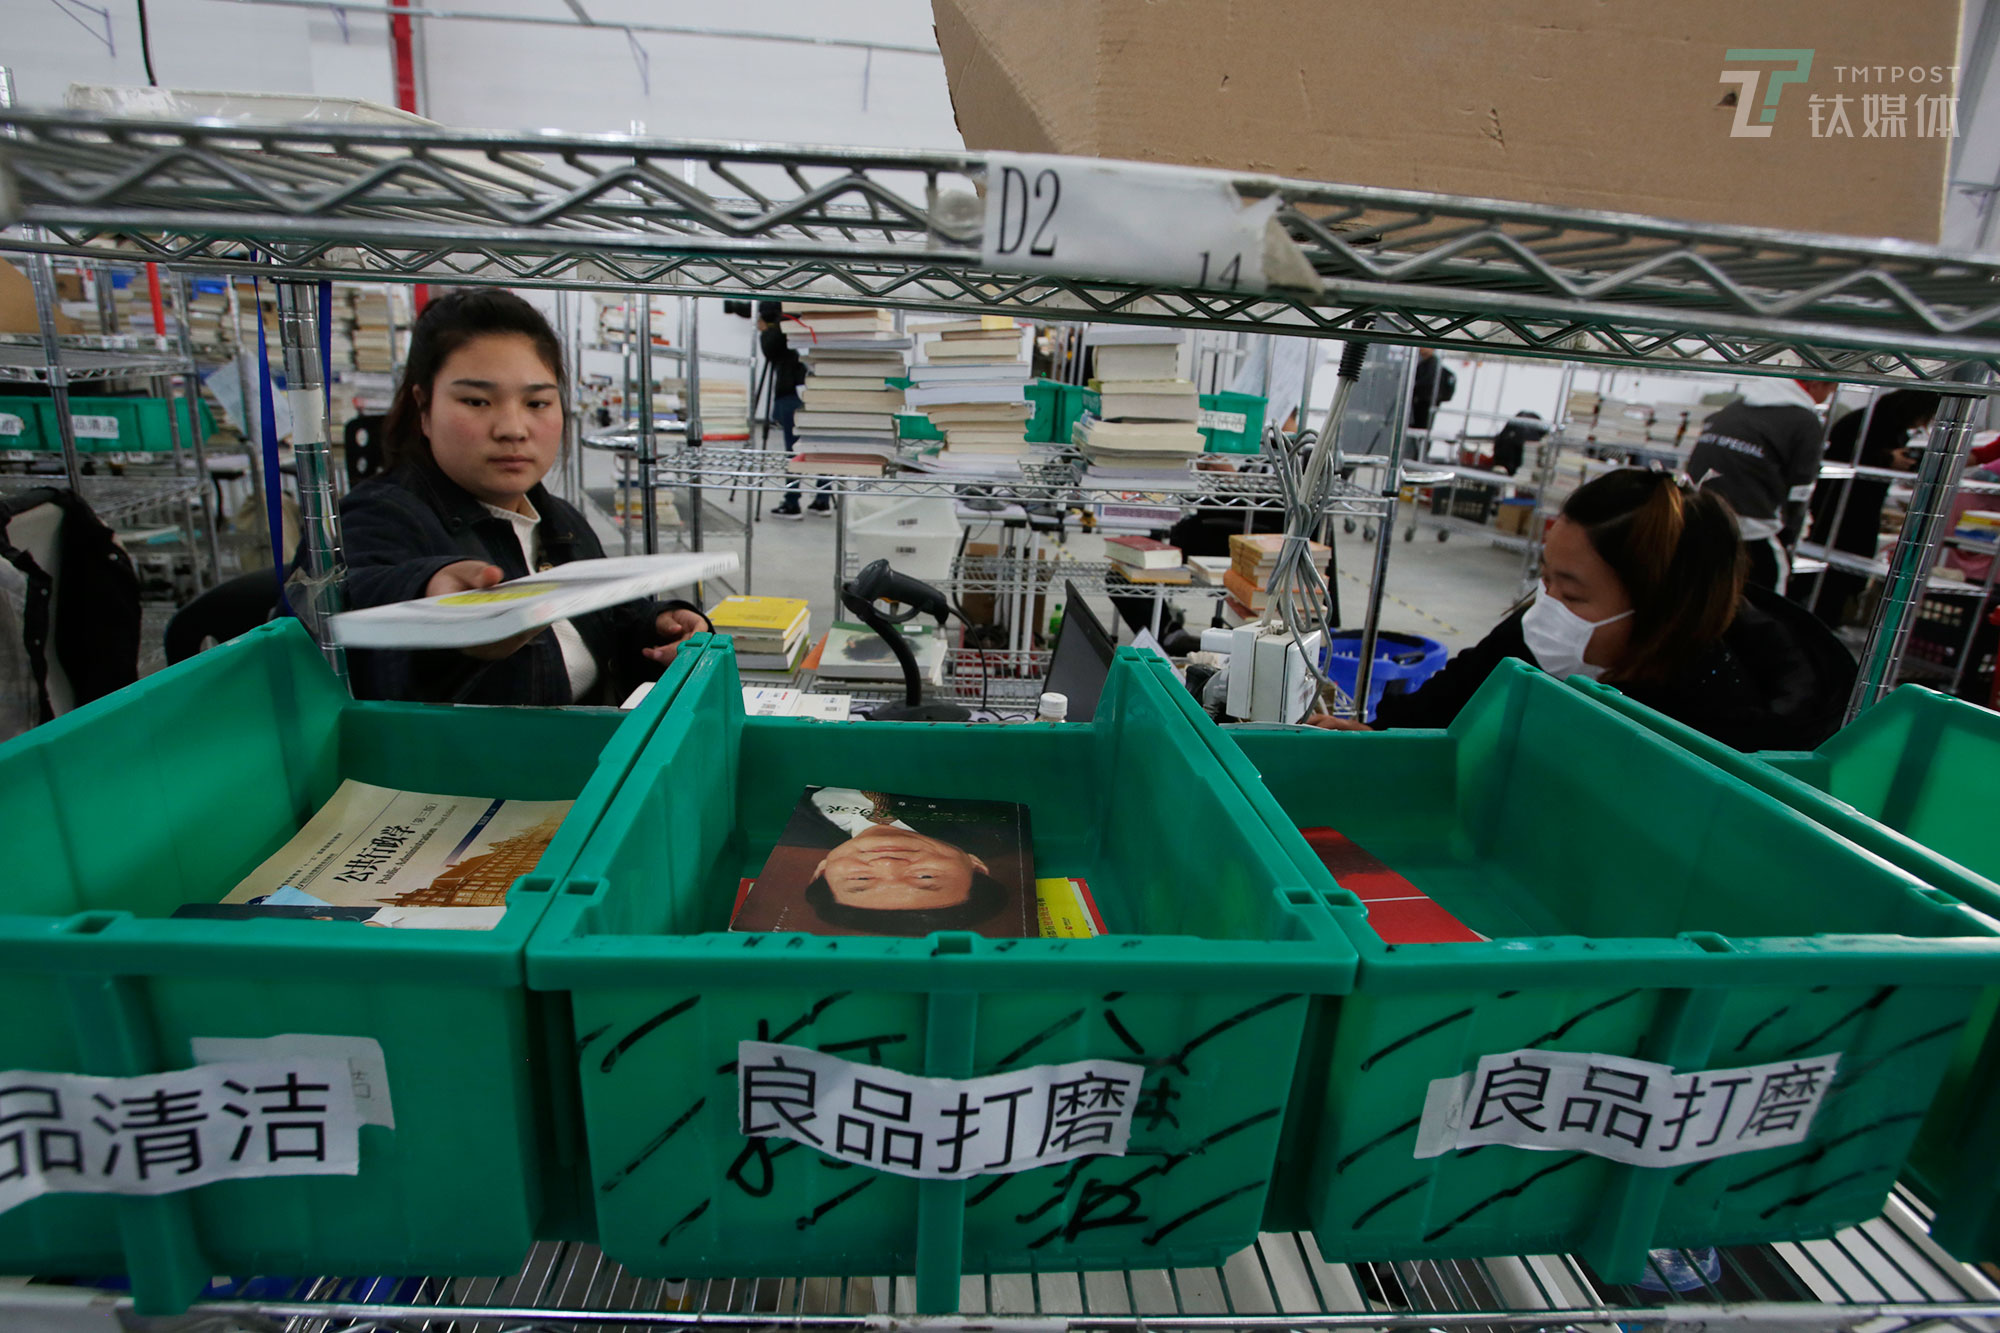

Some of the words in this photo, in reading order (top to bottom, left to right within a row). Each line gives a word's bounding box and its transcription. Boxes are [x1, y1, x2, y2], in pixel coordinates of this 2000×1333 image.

[997, 166, 1061, 257] D2
[1199, 250, 1242, 290] 14
[333, 825, 416, 883] 公共行政学
[375, 866, 402, 885] Public
[396, 827, 438, 868] Administration
[0, 1072, 330, 1181] 品清洁
[741, 1055, 1131, 1174] 良品打磨
[1469, 1056, 1826, 1152] 良品打磨
